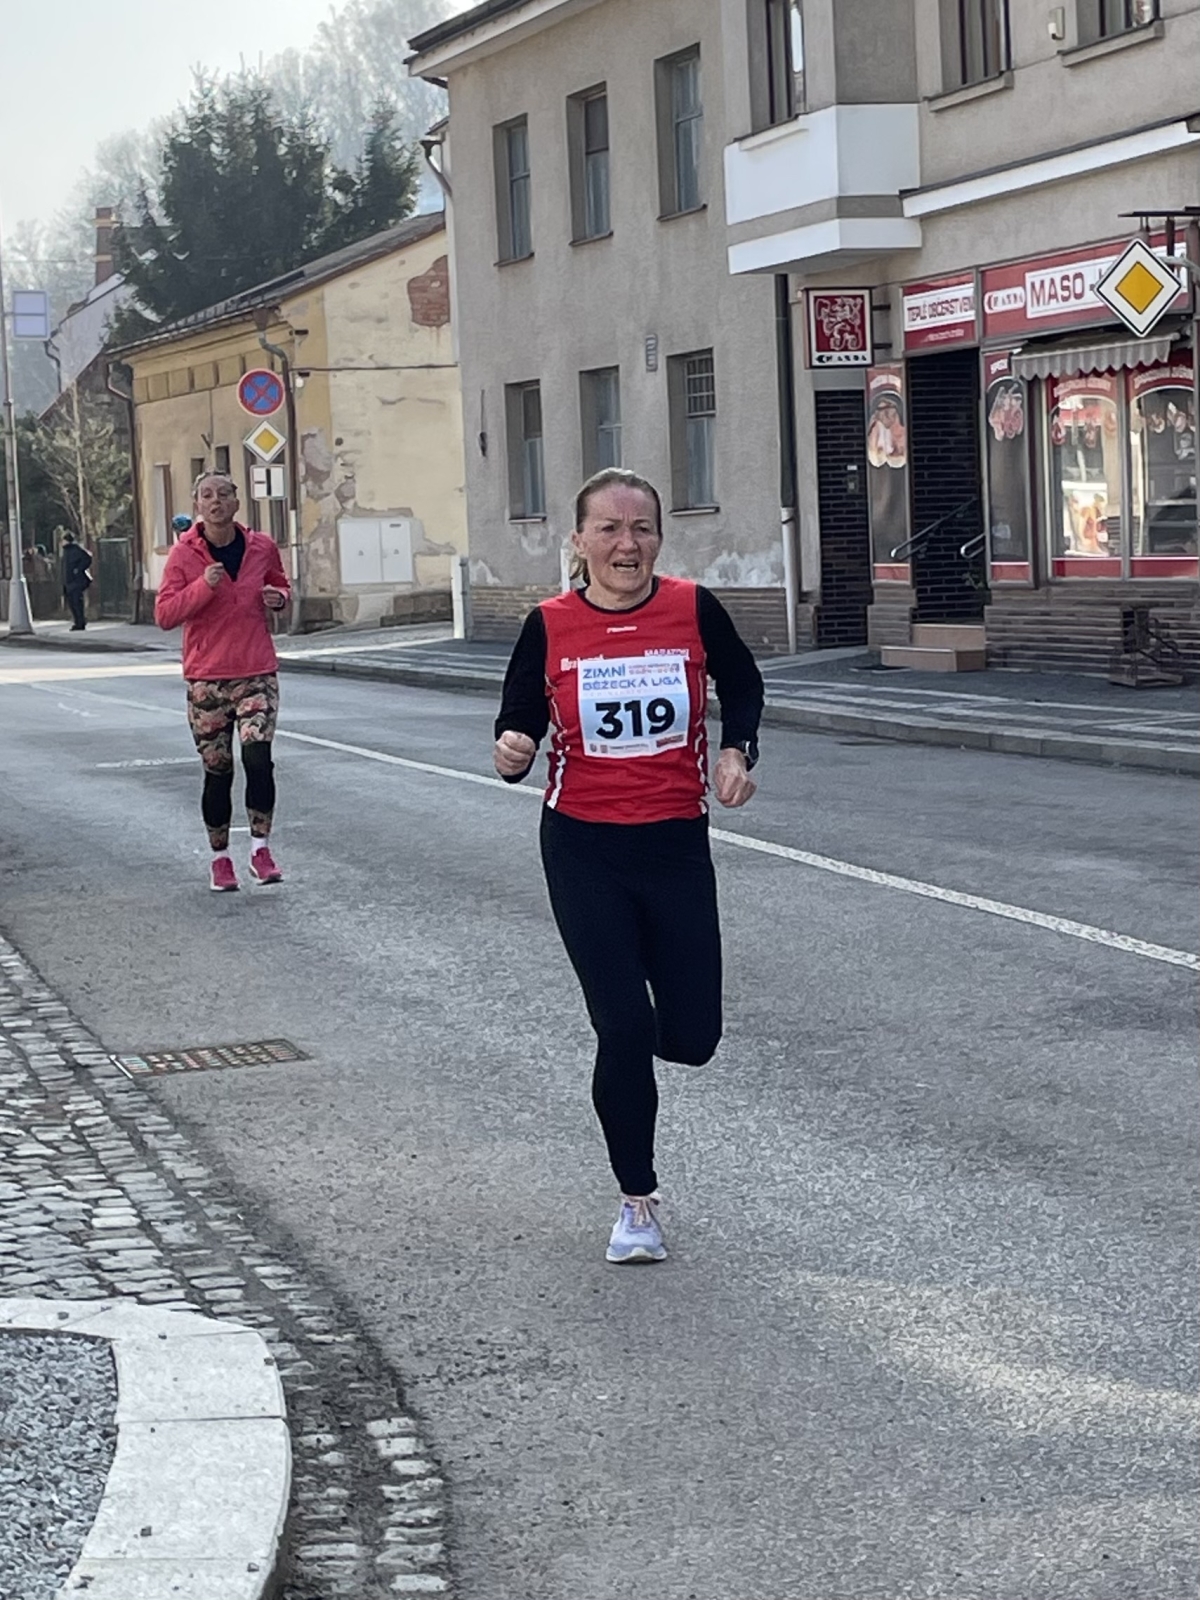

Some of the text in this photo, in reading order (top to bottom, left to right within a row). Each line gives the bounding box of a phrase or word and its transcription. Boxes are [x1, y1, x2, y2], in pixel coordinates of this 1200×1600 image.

[1030, 272, 1085, 308] MASO
[583, 663, 626, 679] ZIMNÍ
[651, 675, 683, 687] LIGA
[595, 698, 675, 740] 319
